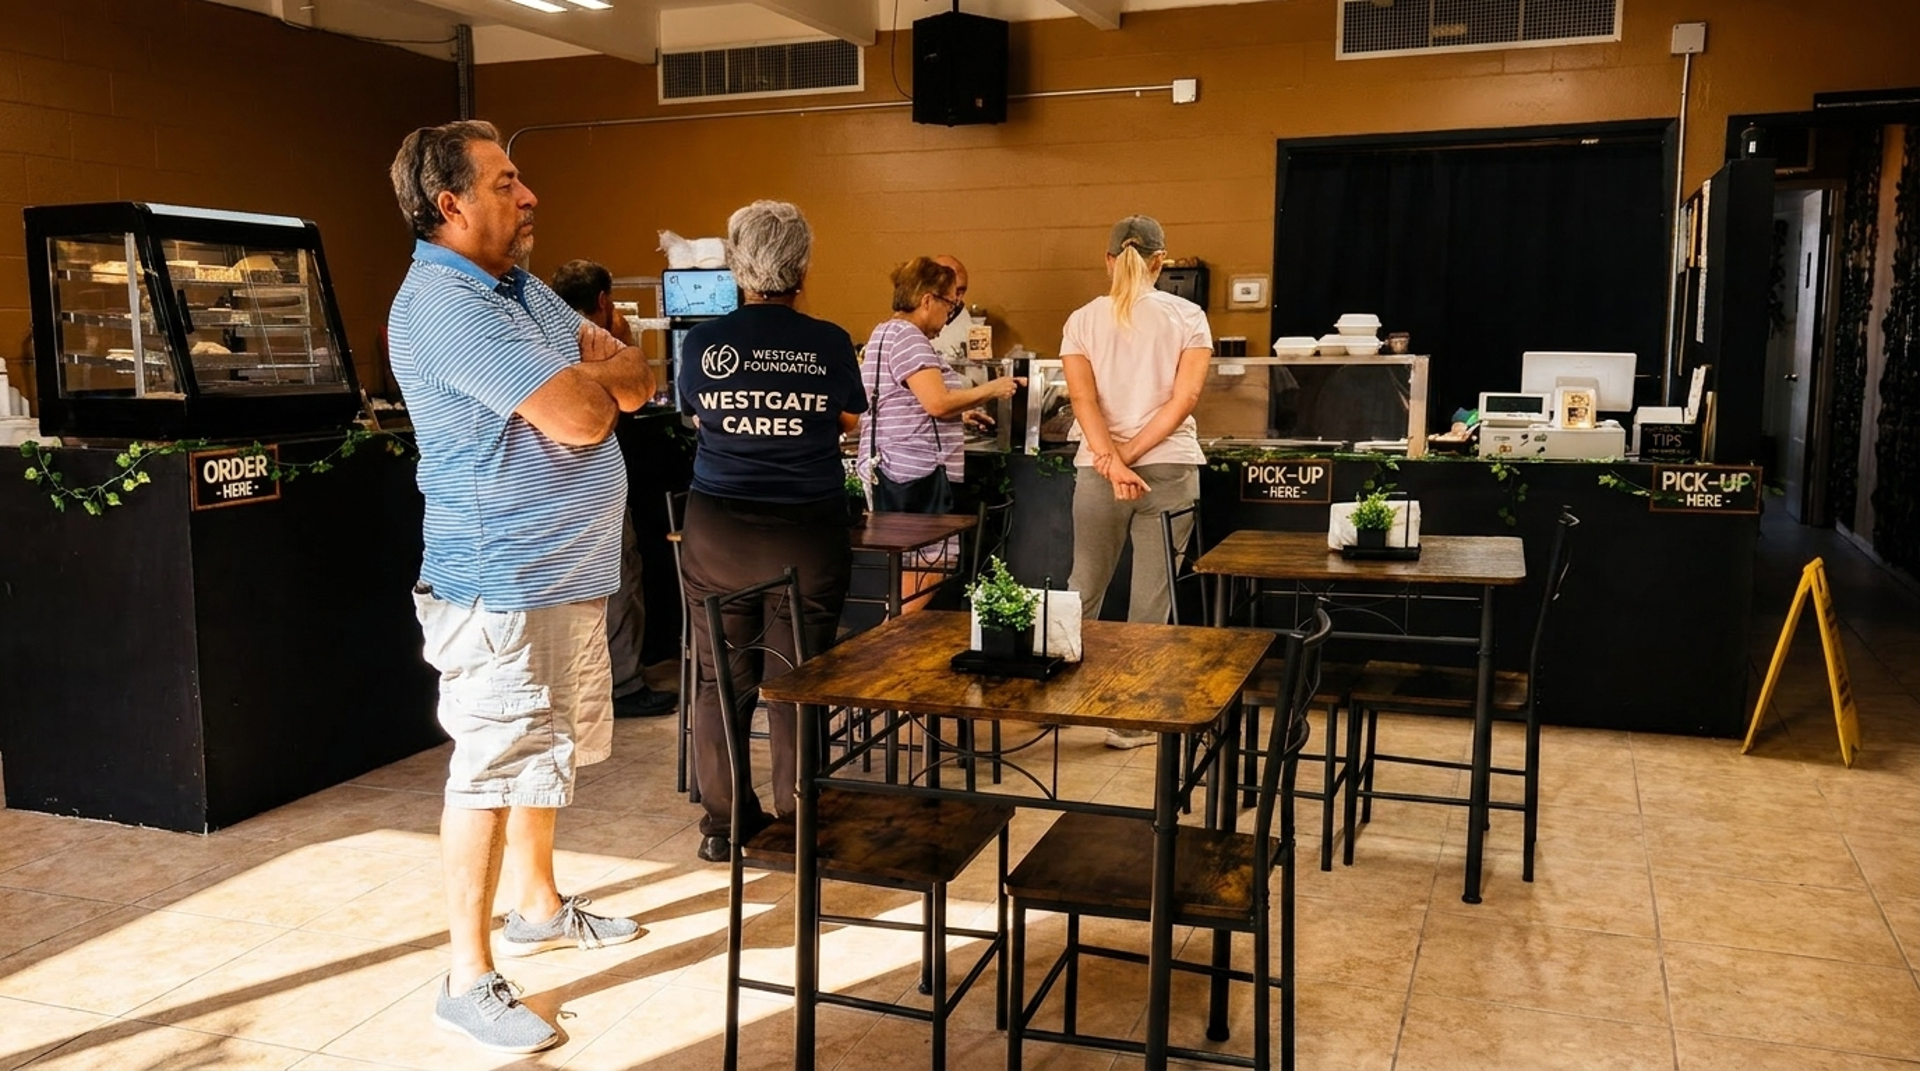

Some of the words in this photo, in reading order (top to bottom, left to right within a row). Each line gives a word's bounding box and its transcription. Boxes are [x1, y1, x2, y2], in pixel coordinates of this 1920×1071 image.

[752, 350, 817, 362] WESTGATE
[744, 361, 827, 375] FOUNDATION
[699, 391, 828, 412] WESTGATE
[722, 416, 803, 436] CARES
[1653, 434, 1682, 447] TIPS
[203, 455, 268, 484] ORDER
[1248, 466, 1324, 484] PICK-UP
[1662, 471, 1751, 492] PICK-UP
